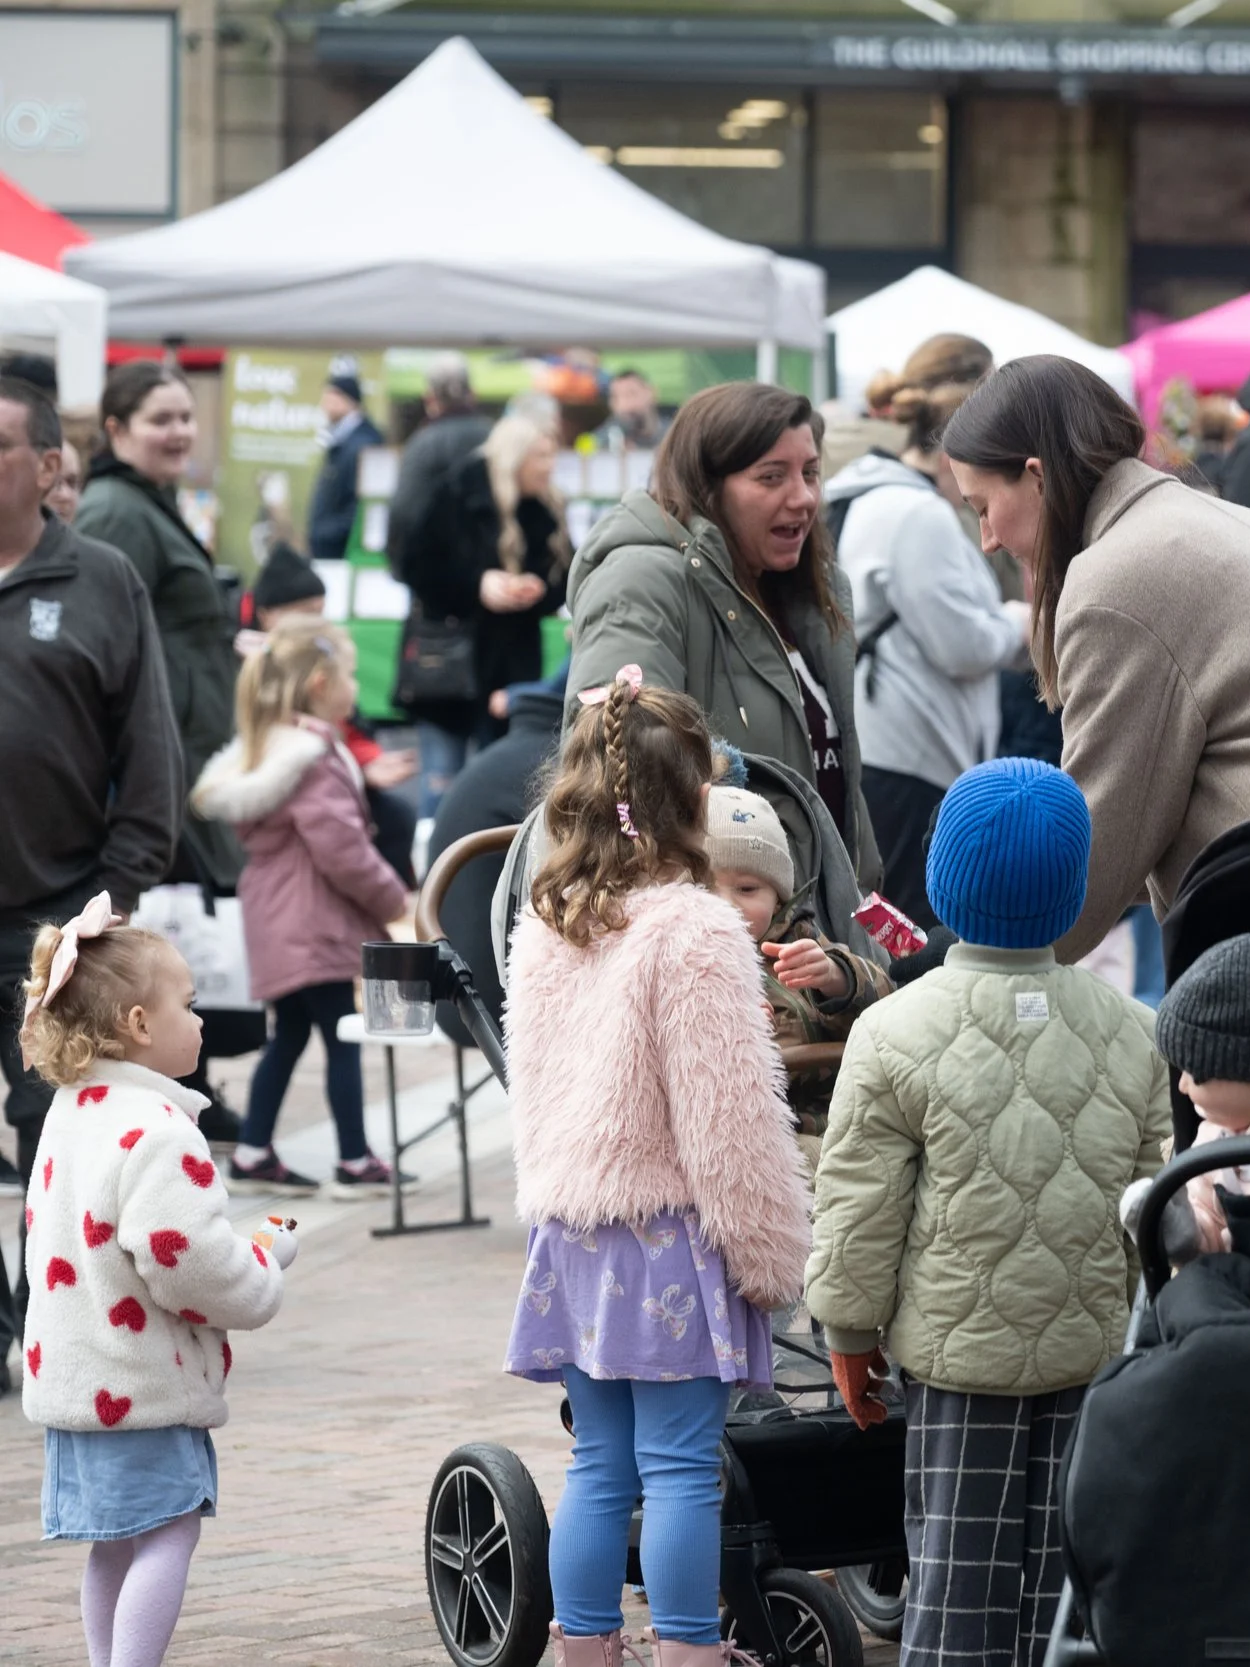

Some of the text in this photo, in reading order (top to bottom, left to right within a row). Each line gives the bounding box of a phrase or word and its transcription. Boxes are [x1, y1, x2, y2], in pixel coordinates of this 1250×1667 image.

[834, 37, 885, 68] THE
[891, 37, 1051, 71] GUILDHALL
[1055, 39, 1203, 73] SHOPPING
